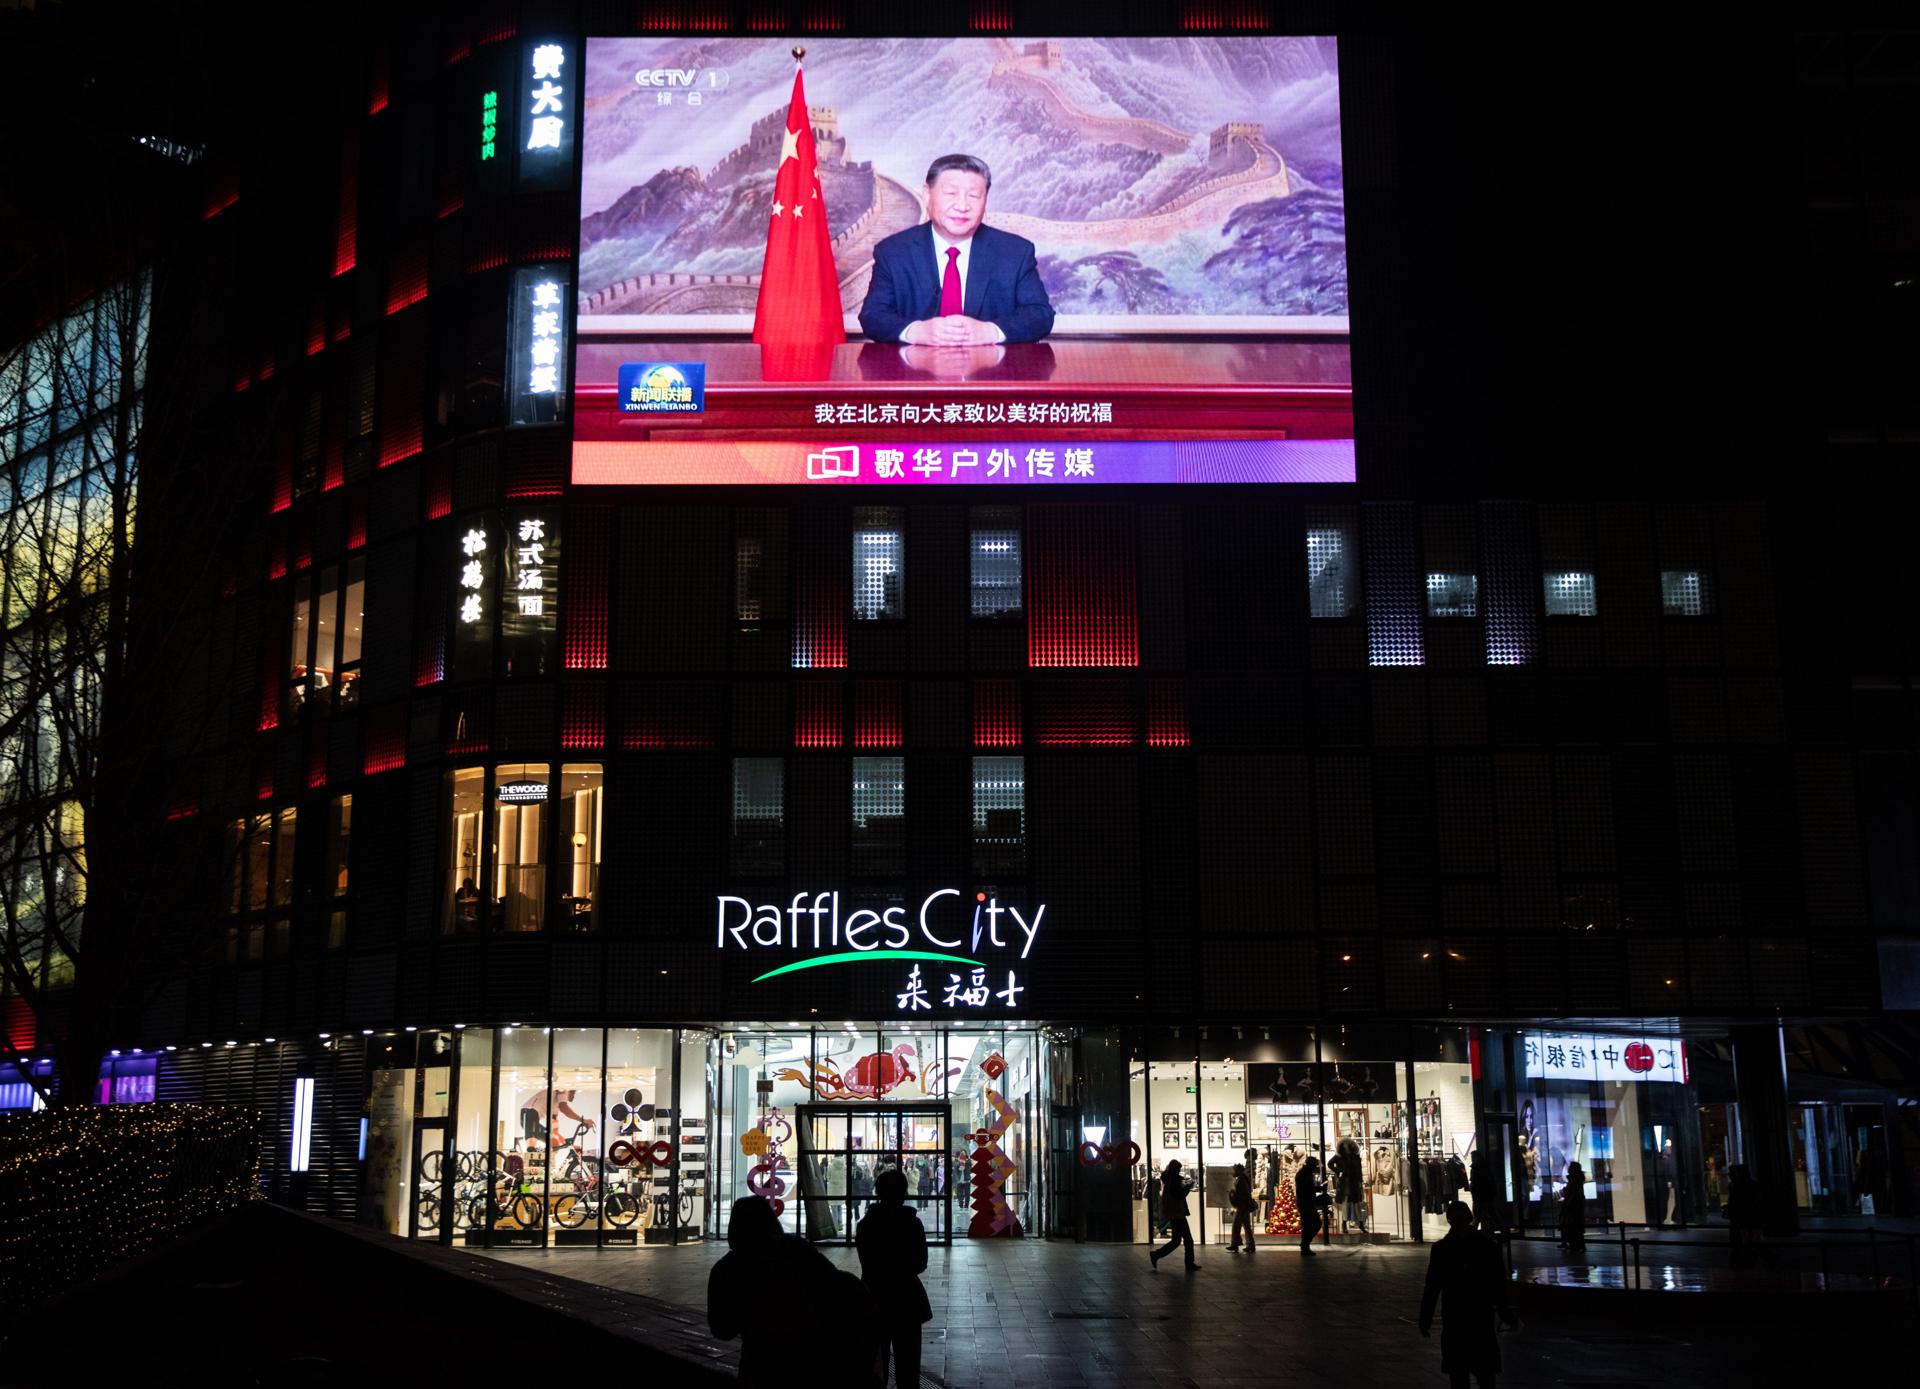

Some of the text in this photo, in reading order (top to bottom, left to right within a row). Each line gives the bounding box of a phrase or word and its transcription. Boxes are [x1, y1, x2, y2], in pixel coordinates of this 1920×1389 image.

[635, 69, 696, 86] CCTV
[625, 403, 698, 411] XINWEN LIANBO
[631, 387, 692, 402] 新闻联播
[814, 403, 1112, 424] 我在北京向大家致以美好的祝福
[874, 448, 1095, 478] 歌华户外传媒
[517, 519, 545, 617] 苏式汤面
[717, 888, 1046, 960] Raffles City
[897, 963, 1025, 1012] 来福士
